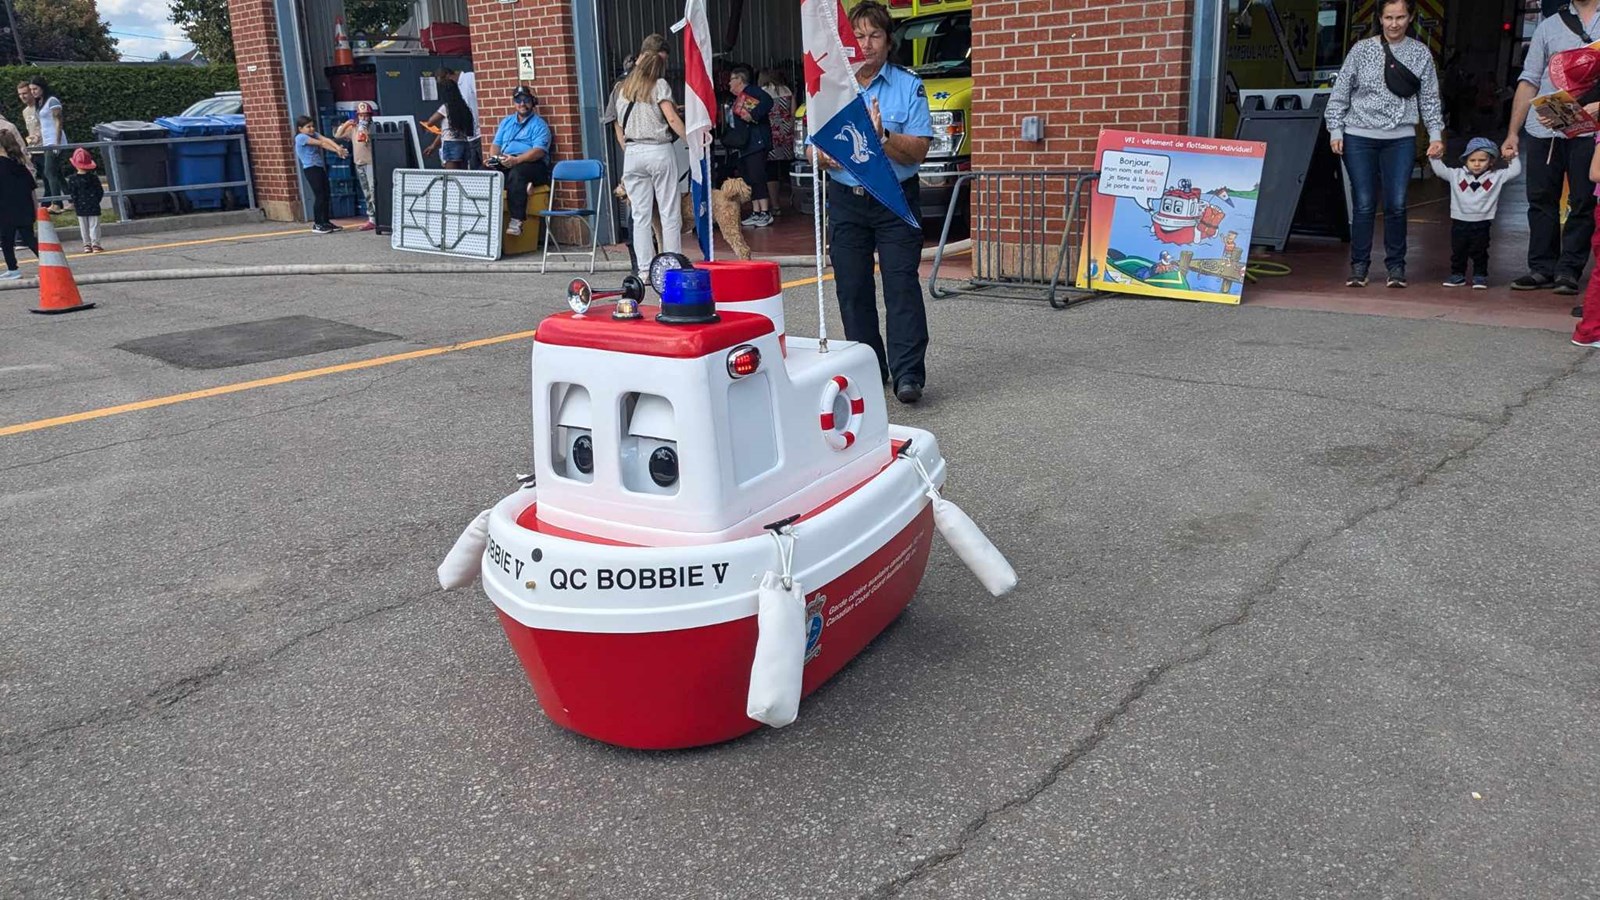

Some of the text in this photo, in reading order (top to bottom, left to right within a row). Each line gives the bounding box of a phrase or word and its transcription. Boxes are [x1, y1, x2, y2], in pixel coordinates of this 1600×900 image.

[1124, 136, 1135, 144] VFI
[1141, 137, 1173, 147] vêtement
[1175, 140, 1184, 148] de
[1186, 141, 1218, 151] flottaison
[1219, 144, 1253, 154] individuel
[515, 558, 525, 580] V
[550, 562, 729, 590] QC BOBBIE V
[826, 603, 854, 627] Canadian
[855, 589, 871, 607] Coast
[871, 575, 886, 595] Guard
[829, 598, 848, 616] Garde
